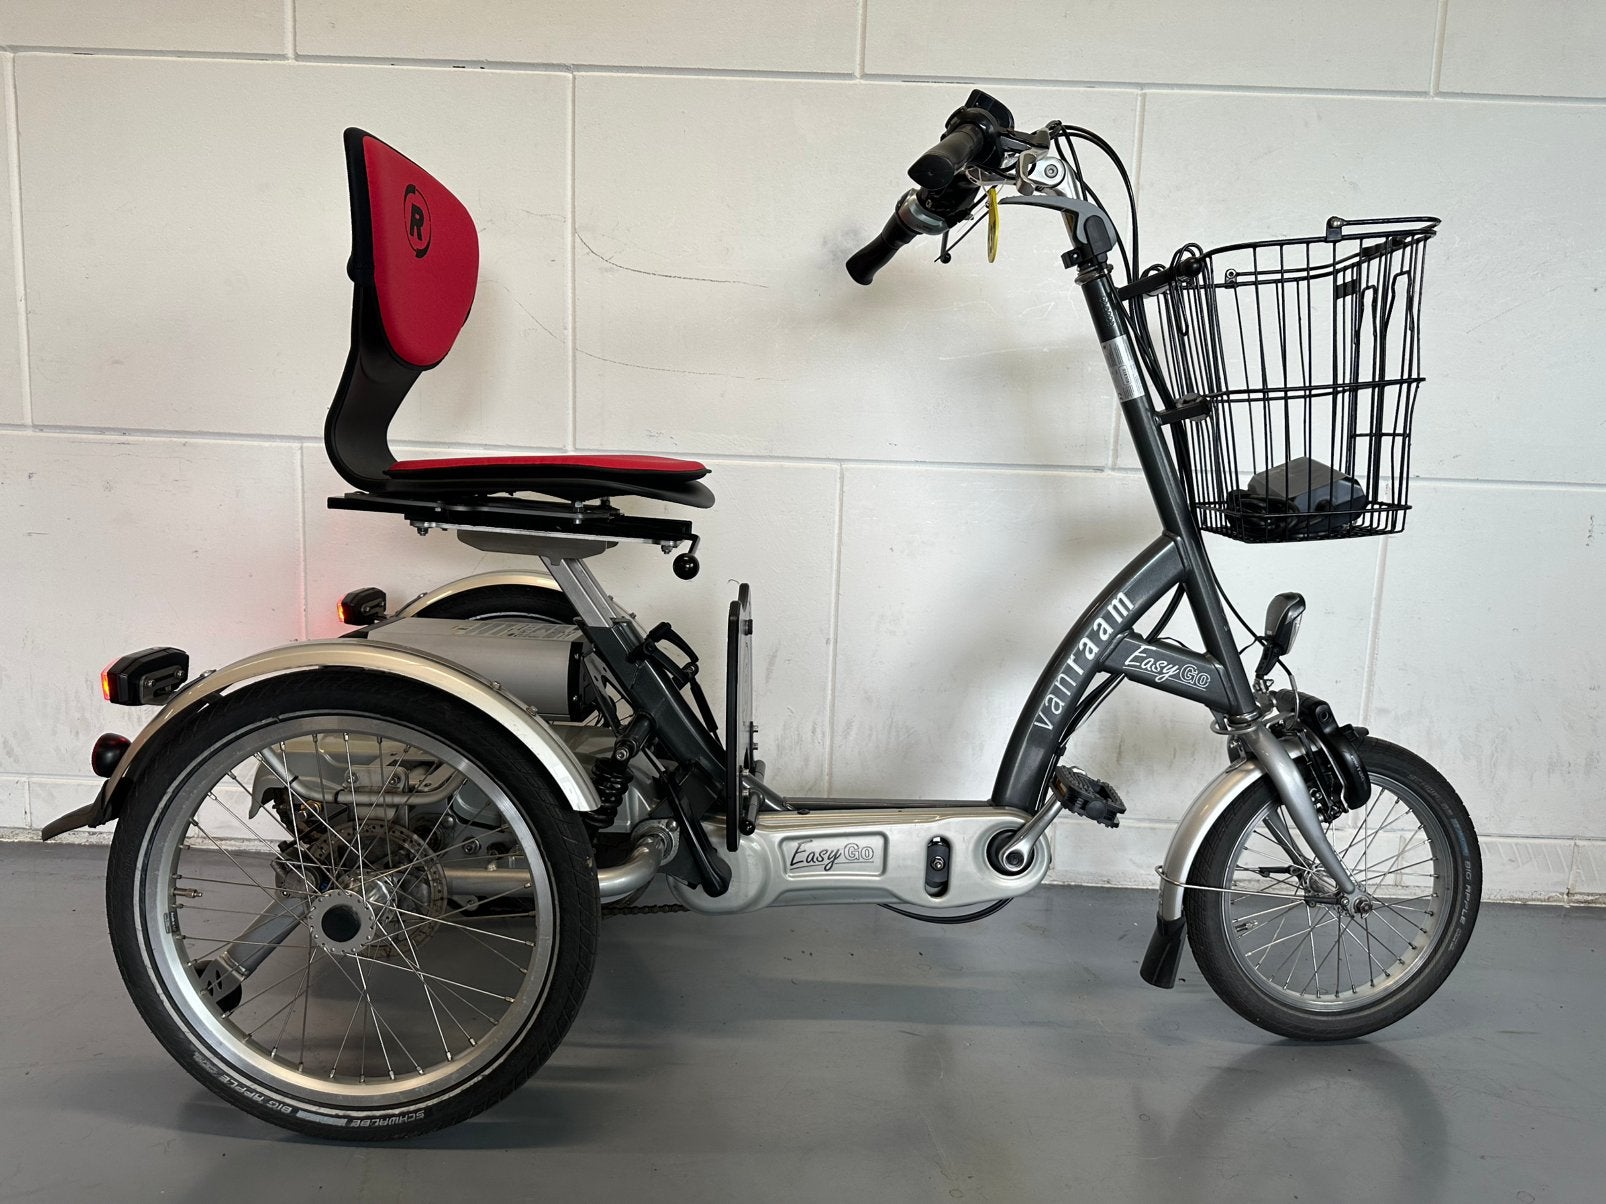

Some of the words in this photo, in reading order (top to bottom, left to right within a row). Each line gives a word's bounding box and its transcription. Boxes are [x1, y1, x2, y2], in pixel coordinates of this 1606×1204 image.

[409, 202, 425, 242] R
[1034, 591, 1135, 731] vanraam
[219, 1074, 265, 1104] APPLE
[266, 1099, 293, 1114] BIG
[350, 1109, 426, 1128] SCHWALBE
